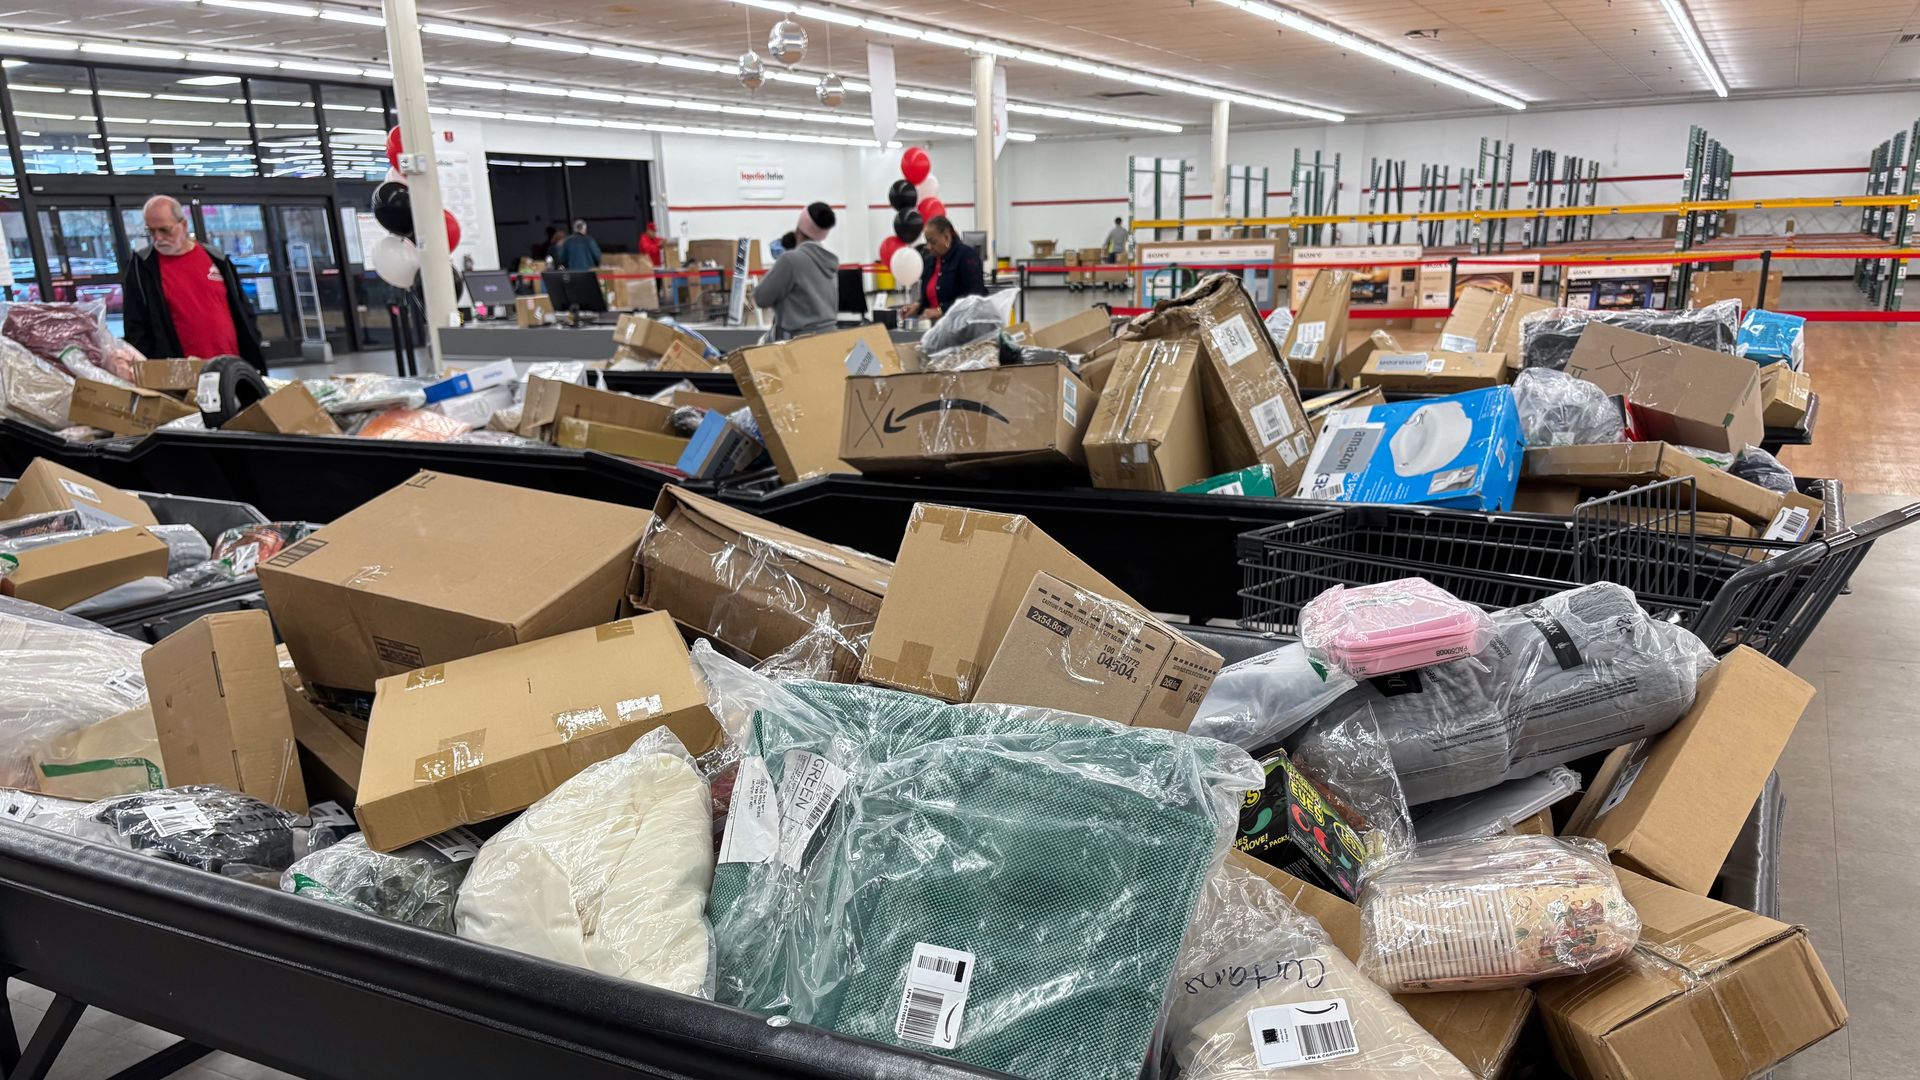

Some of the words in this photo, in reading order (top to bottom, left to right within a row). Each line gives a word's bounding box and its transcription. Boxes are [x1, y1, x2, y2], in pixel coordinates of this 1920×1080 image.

[1908, 215, 1914, 225] 2
[1336, 430, 1365, 471] amazon
[1030, 609, 1068, 635] 2x54.8oz
[1095, 650, 1135, 679] 04504
[795, 758, 825, 810] GREEN
[1290, 782, 1324, 826] EYES
[1241, 833, 1268, 853] MOVE!
